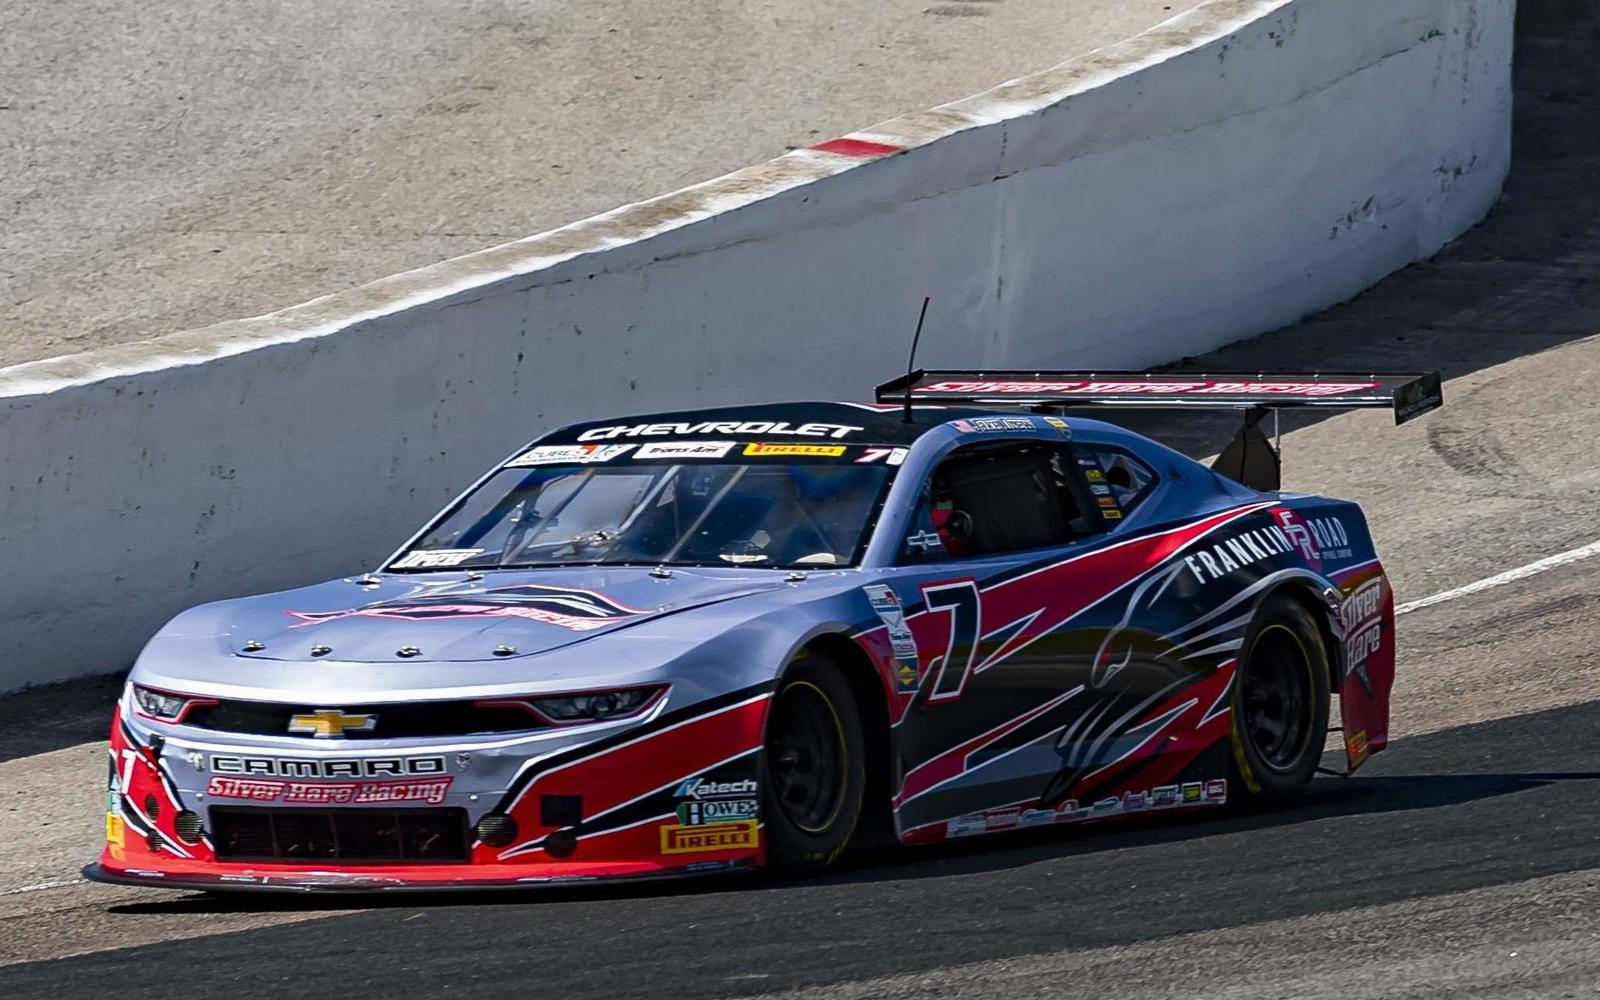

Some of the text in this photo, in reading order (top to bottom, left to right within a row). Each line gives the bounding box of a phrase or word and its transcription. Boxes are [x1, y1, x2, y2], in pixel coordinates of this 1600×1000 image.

[577, 421, 865, 442] CHEVROLET
[752, 443, 835, 453] PIRELLI
[853, 448, 892, 464] 7
[1184, 517, 1348, 585] FRANKLIN ROAD
[1341, 577, 1382, 633] Silver
[921, 580, 981, 701] 7
[1345, 616, 1382, 676] Hare
[209, 755, 448, 778] CAMARO
[208, 776, 454, 804] Silver Hare Racing
[684, 778, 758, 800] Katech
[667, 823, 751, 850] PIRELLI
